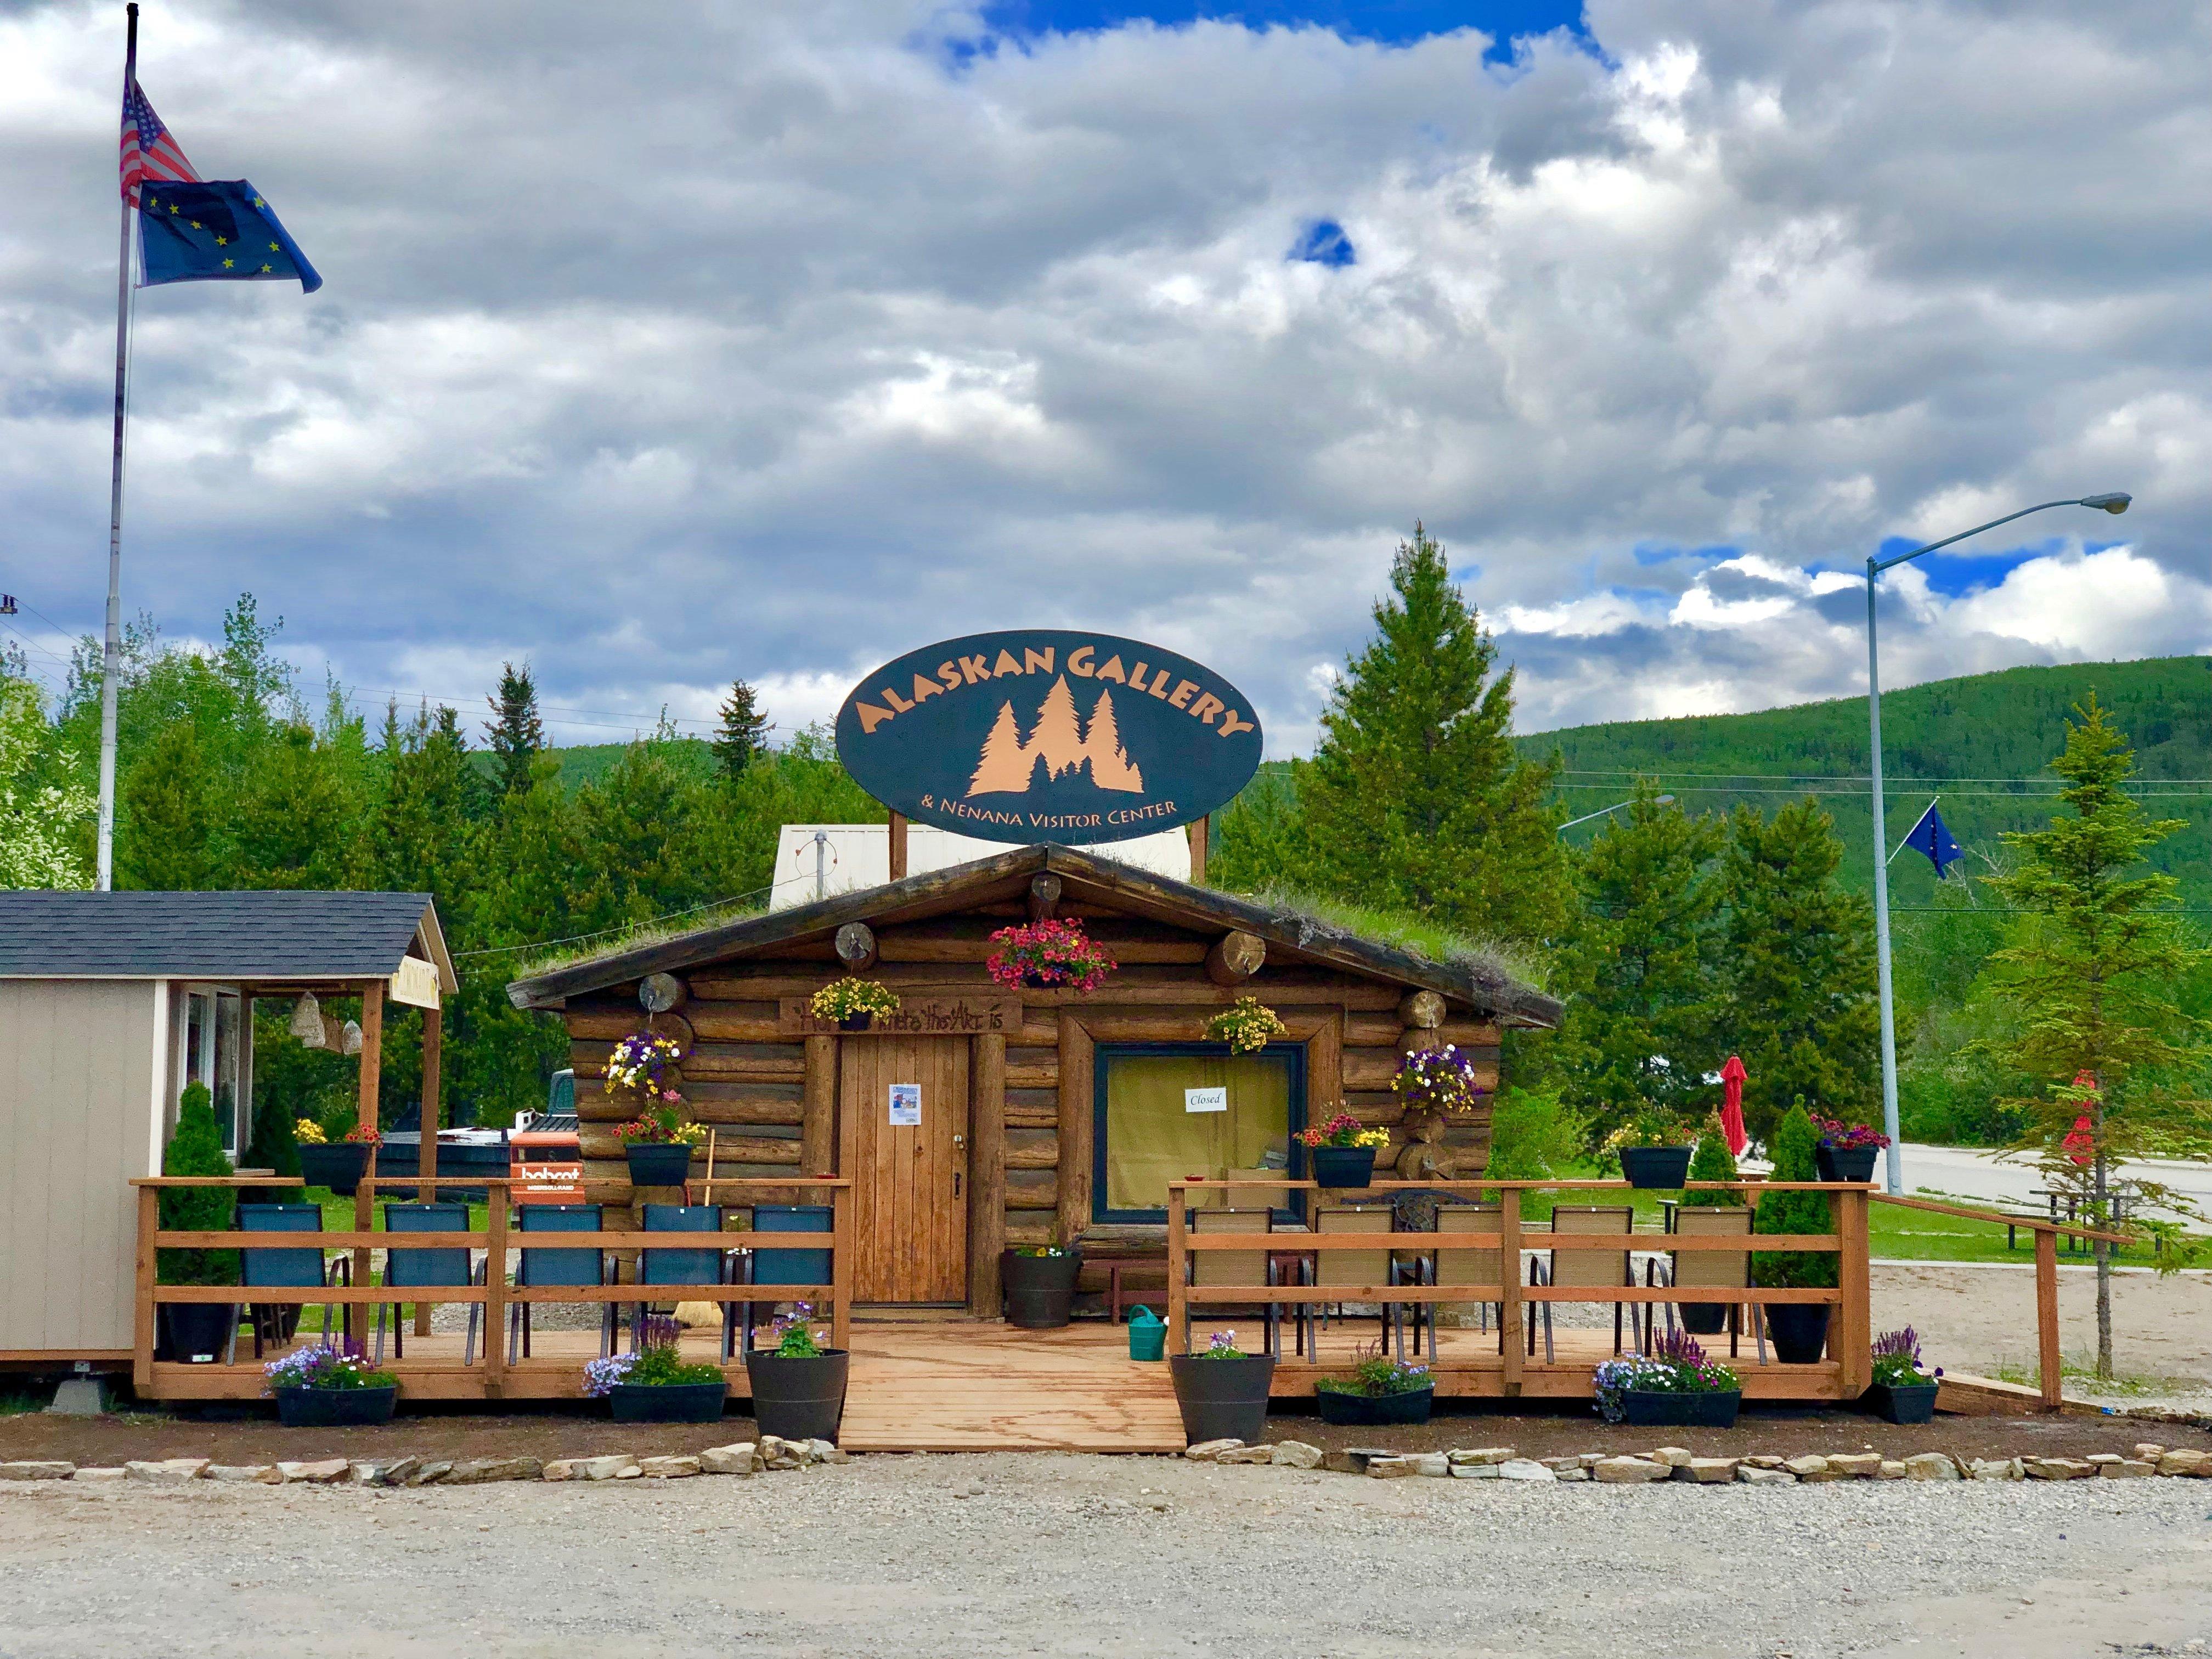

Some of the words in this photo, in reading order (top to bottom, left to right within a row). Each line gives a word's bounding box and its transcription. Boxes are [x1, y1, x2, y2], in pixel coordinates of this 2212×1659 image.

[855, 646, 1055, 734] ALASKAN
[1067, 645, 1255, 738] GALLERY
[921, 794, 934, 808] &
[1190, 1093, 1222, 1105] Closed
[522, 1167, 580, 1180] bobcat
